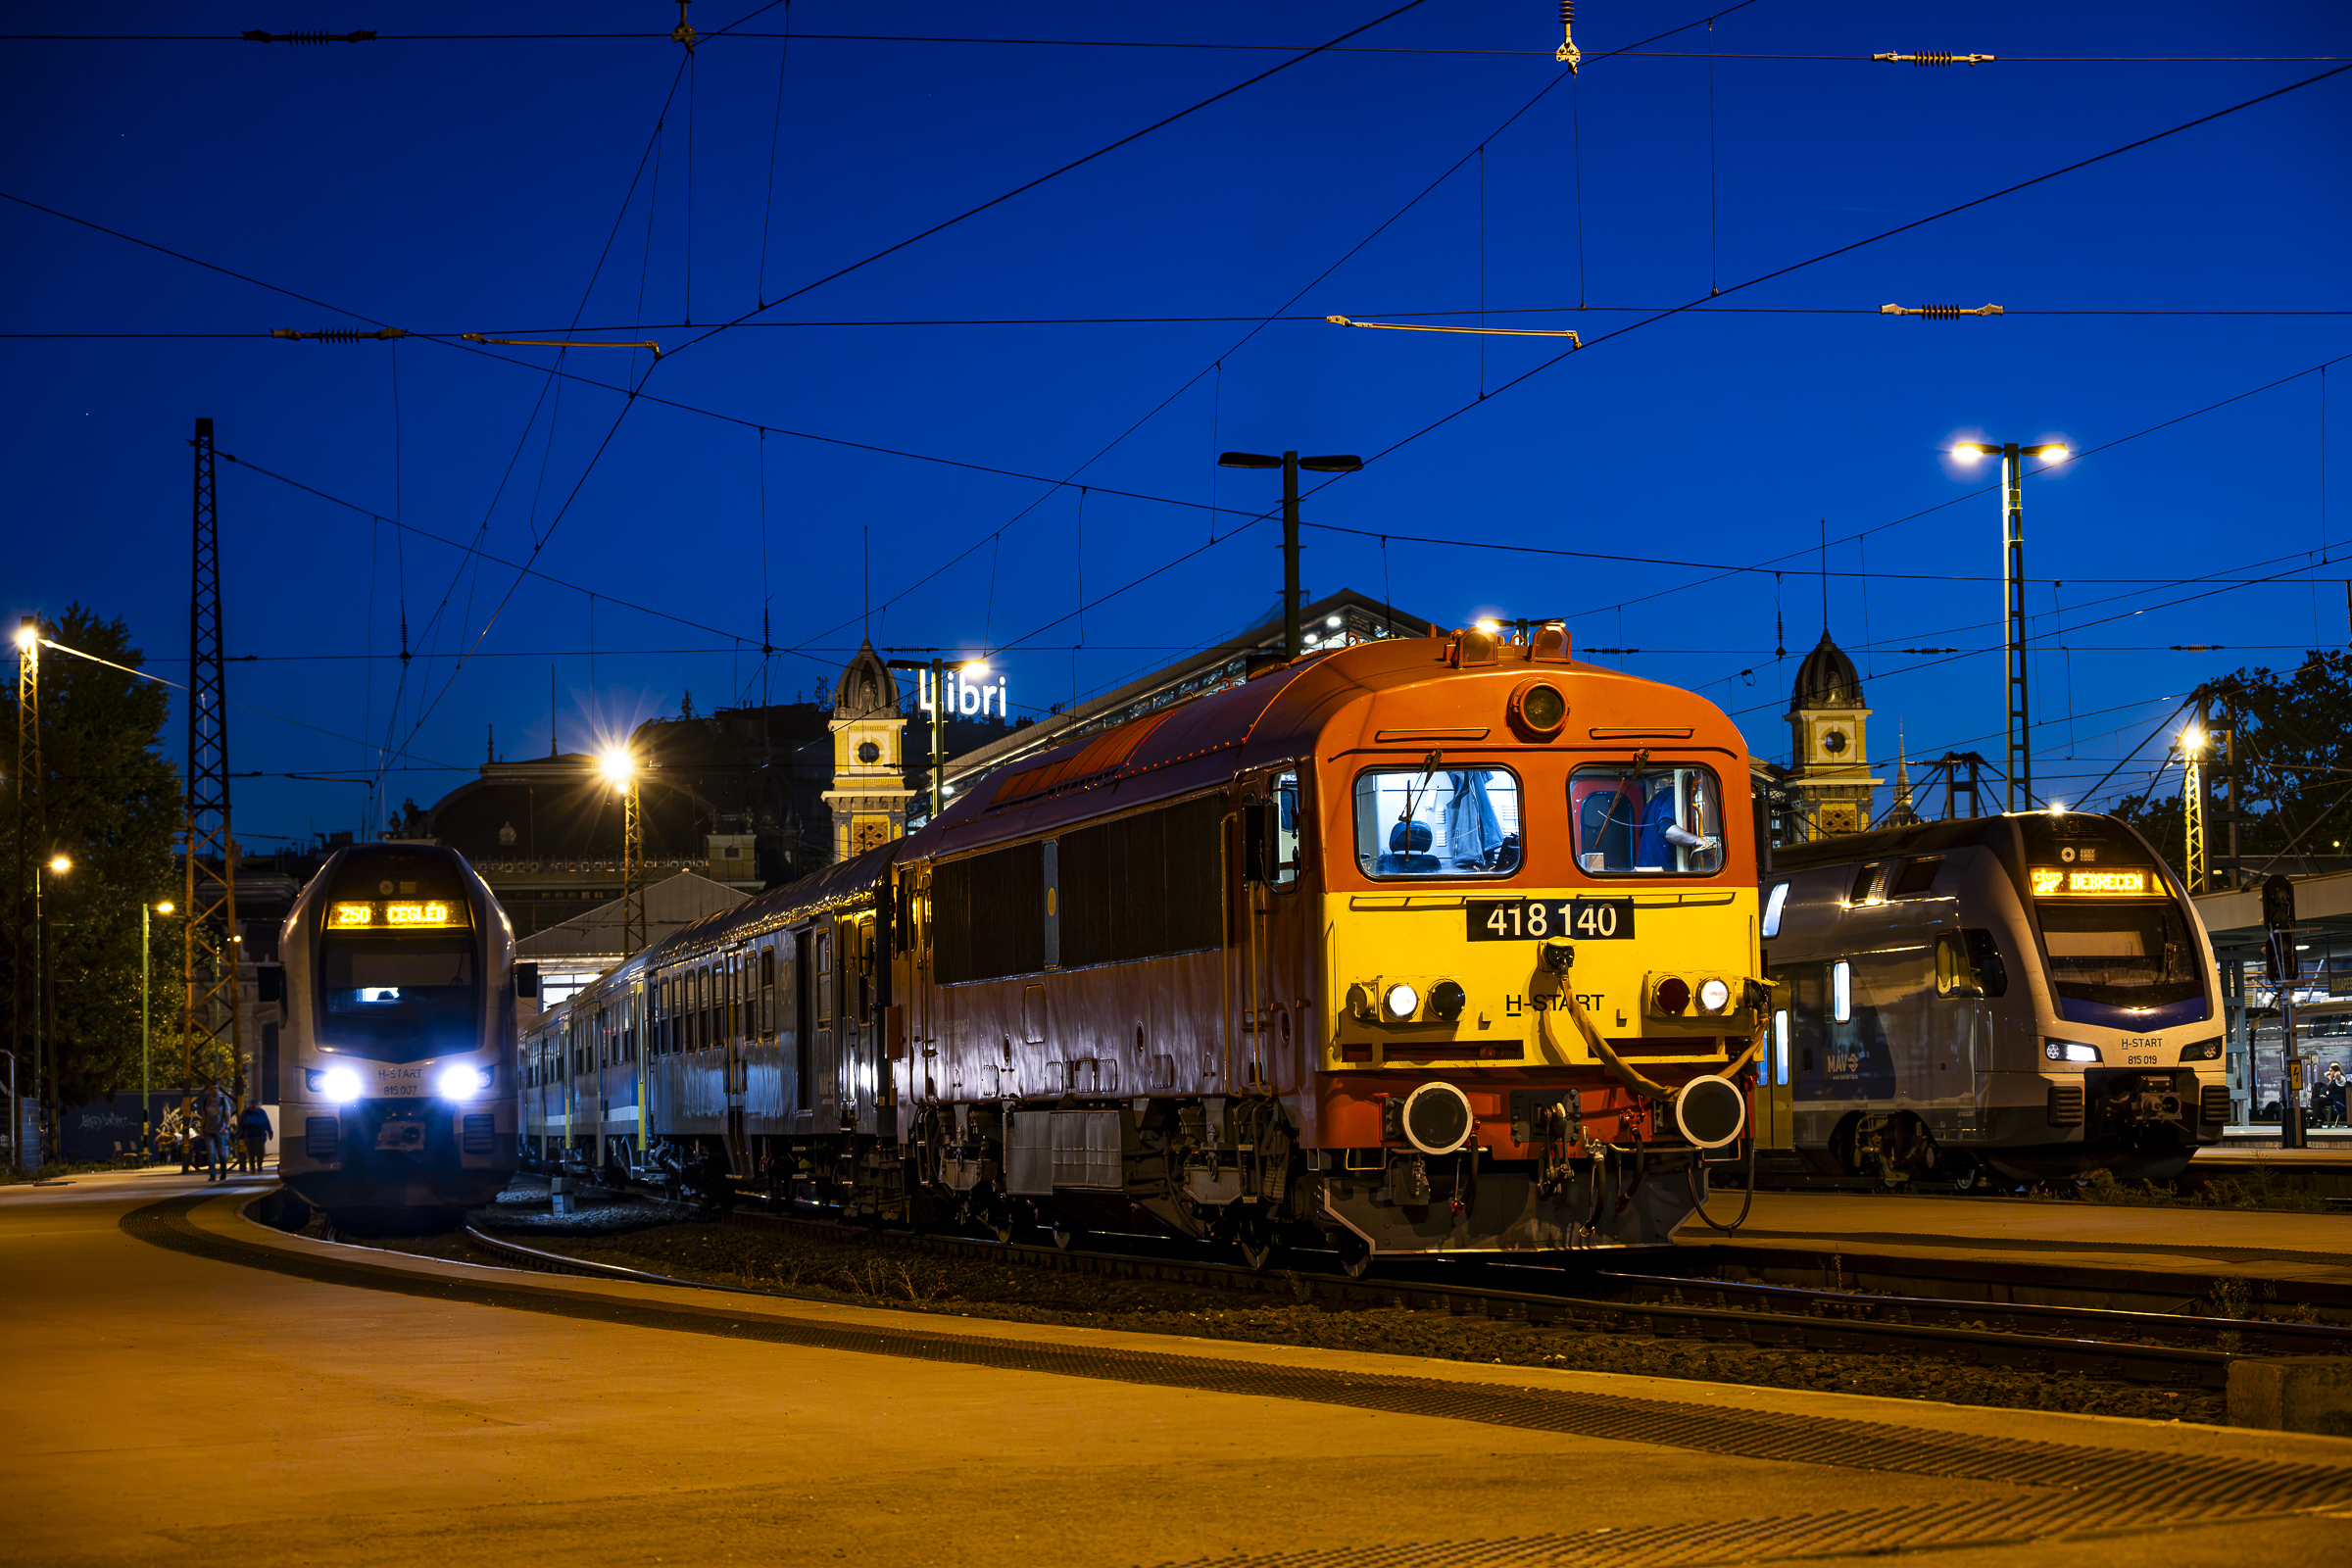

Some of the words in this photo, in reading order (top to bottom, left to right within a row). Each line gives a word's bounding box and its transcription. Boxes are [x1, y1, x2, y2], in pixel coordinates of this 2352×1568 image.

[2070, 873, 2143, 890] DEBRECEN
[339, 906, 370, 922] Z50
[388, 903, 447, 922] CEGLÉD
[1487, 903, 1547, 936] 418
[1558, 903, 1617, 936] 140
[2121, 1038, 2163, 1050] H-START
[2128, 1054, 2142, 1065] 815
[2143, 1054, 2158, 1065] 019
[378, 1068, 422, 1081] H-START
[383, 1085, 399, 1096] 815
[400, 1085, 417, 1096] 007
